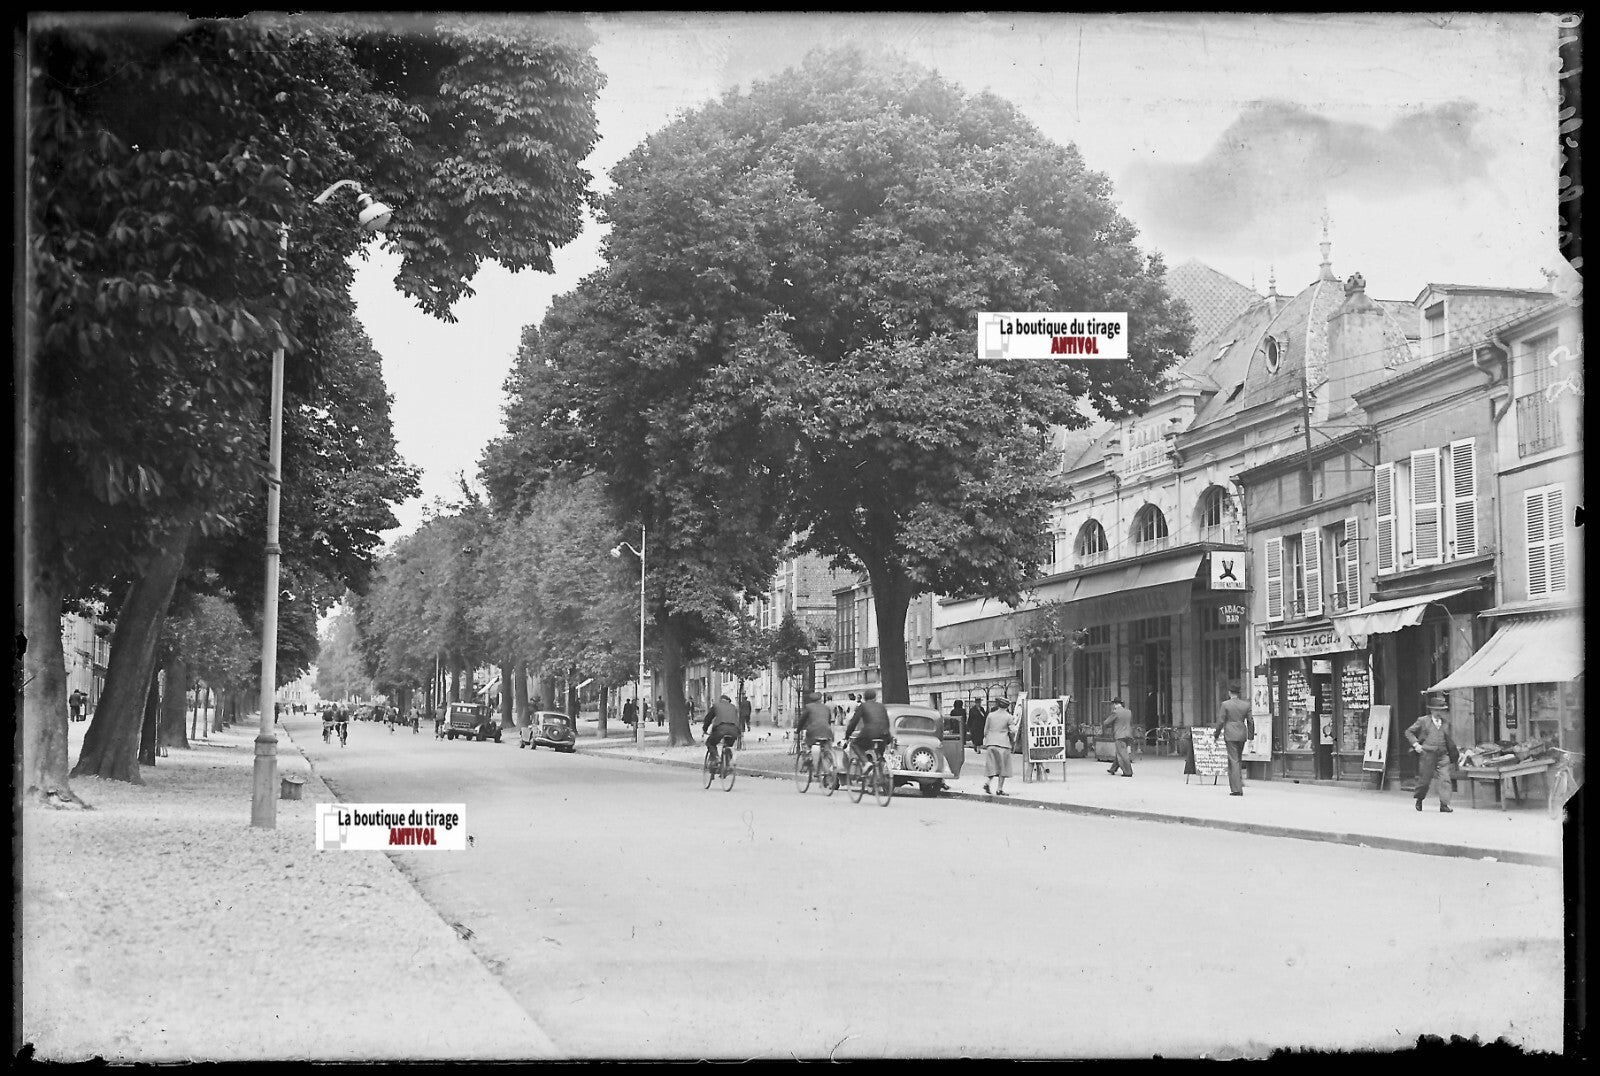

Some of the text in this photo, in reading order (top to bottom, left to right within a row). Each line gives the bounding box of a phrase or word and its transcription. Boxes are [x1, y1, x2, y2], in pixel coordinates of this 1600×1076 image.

[1219, 605, 1245, 615] TABACS
[1225, 615, 1240, 623] BAR
[1283, 637, 1297, 649] AU
[1303, 632, 1341, 648] PACHA
[1029, 725, 1063, 737] TIRAGE
[1033, 736, 1060, 748] JEUDI
